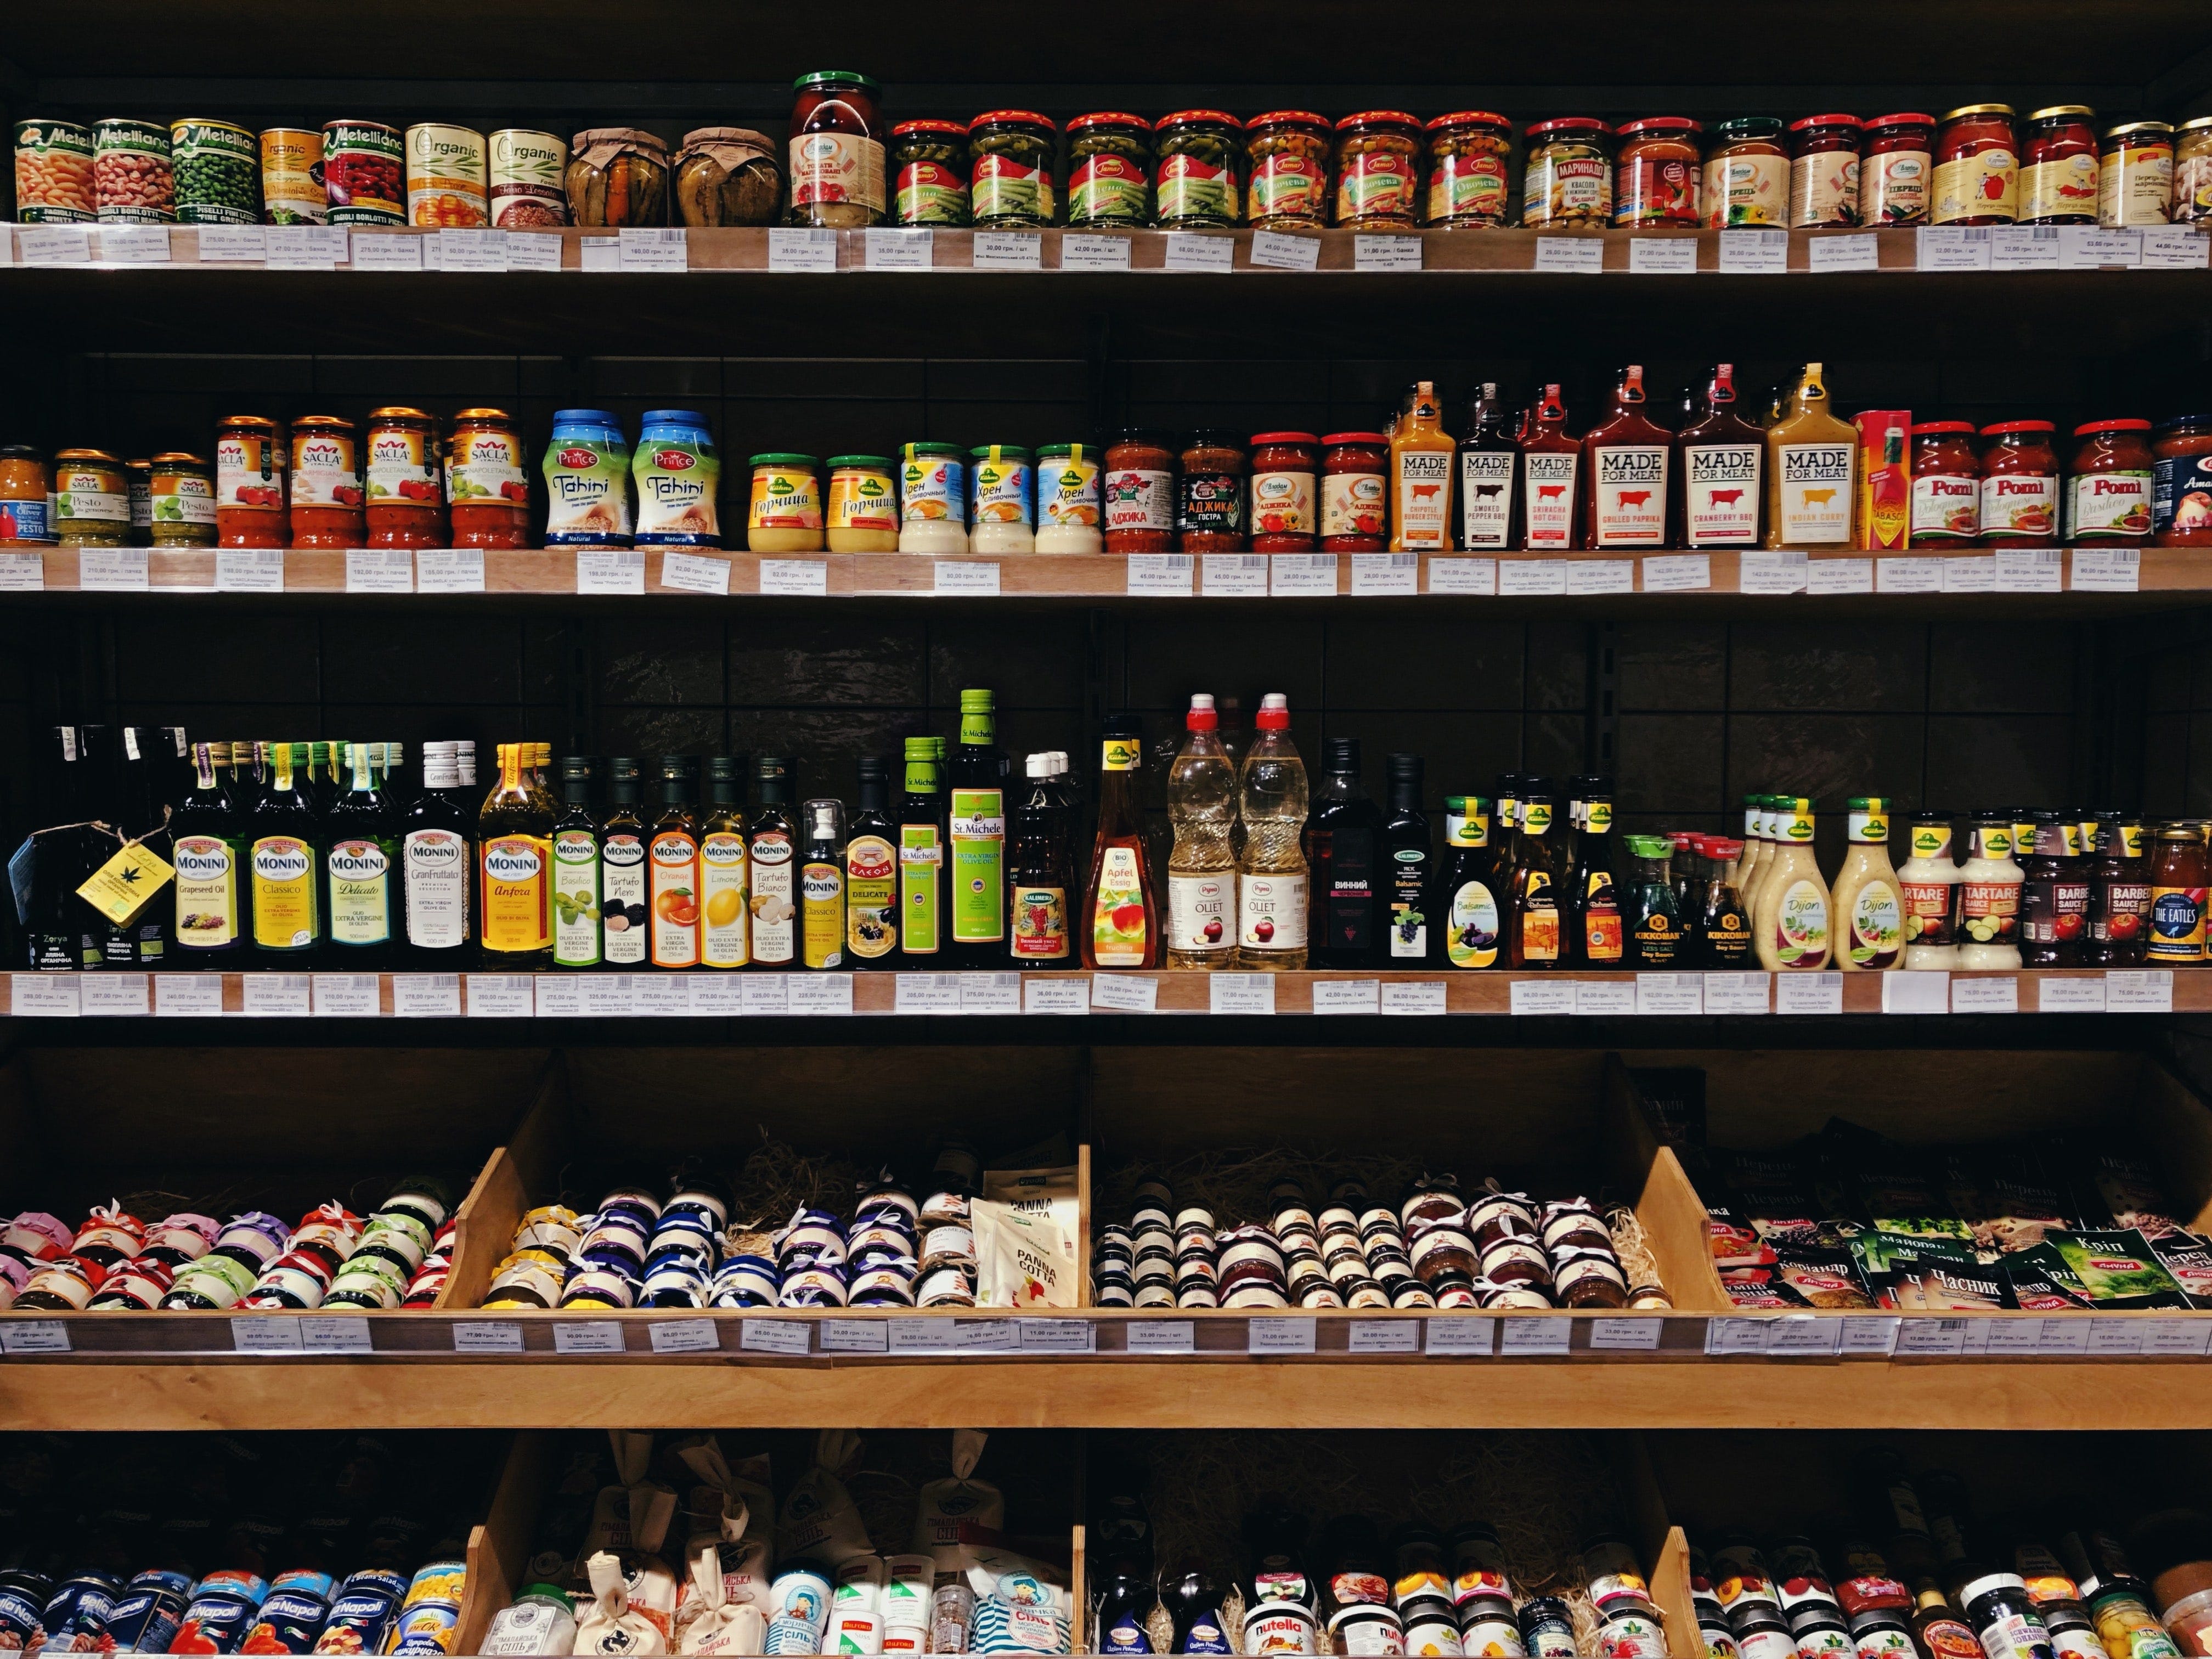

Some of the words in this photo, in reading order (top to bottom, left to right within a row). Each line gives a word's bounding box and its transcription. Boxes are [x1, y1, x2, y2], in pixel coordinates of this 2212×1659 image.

[416, 129, 478, 158] Organic
[498, 137, 557, 162] Organic
[1559, 162, 1603, 177] МАРИНАДО
[558, 452, 596, 465] Prince
[655, 454, 693, 466] Prince
[1404, 458, 1447, 469] MADE
[1467, 458, 1509, 469] MADE
[1602, 455, 1661, 470] MADE
[1693, 453, 1754, 470] MADE
[1786, 452, 1847, 469] MADE
[1530, 459, 1572, 470] MADE
[1601, 472, 1626, 481] FOR
[1629, 471, 1662, 479] MEAT
[1692, 470, 1718, 479] FOR
[1722, 469, 1755, 478] MEAT
[1786, 469, 1810, 478] FOR
[1814, 469, 1848, 477] MEAT
[553, 476, 608, 499] Tahini
[647, 476, 703, 500] Tahini
[904, 483, 925, 495] Хрен
[978, 485, 1001, 498] Хрен
[910, 489, 946, 500] сливочный
[984, 493, 1021, 502] сливочный
[1057, 488, 1084, 500] Хрен
[74, 496, 101, 506] Pesto
[182, 501, 208, 511] Pesto
[755, 494, 808, 518] Горчица
[843, 498, 894, 517] Горчица
[1188, 502, 1233, 514] АДЖИКА
[1112, 512, 1147, 524] АДЖИКА
[1873, 510, 1905, 520] TABASCO
[18, 524, 44, 533] PESTO
[414, 847, 454, 857] MONINI
[178, 857, 224, 868] MONINI
[257, 857, 304, 869] MONINI
[332, 857, 383, 870] MONINI
[488, 857, 537, 870] MONINI
[411, 869, 458, 879] GranFruttato
[661, 872, 689, 883] Orange
[756, 873, 788, 882] Tartufo
[1108, 868, 1133, 879] Apfel
[561, 876, 590, 885] Basilico
[609, 877, 639, 886] Tartufo
[1110, 879, 1131, 888] Essig
[1335, 880, 1367, 889] ВИННИЙ
[180, 885, 213, 895] Grapeseed
[216, 885, 224, 893] Oil
[263, 884, 300, 894] Classico
[337, 883, 379, 895] Delicato
[495, 886, 531, 896] Anfora
[614, 887, 634, 896] Nero
[758, 883, 787, 893] Bianco
[1202, 885, 1218, 894] Руна
[1255, 885, 1269, 893] Руна
[1966, 887, 2018, 899] TARTARE
[1195, 902, 1223, 913] ОЦЕТ
[1249, 902, 1276, 913] ОЦЕТ
[1457, 901, 1492, 911] Balsamic
[1788, 900, 1819, 911] Dijon
[1862, 900, 1893, 911] Dijon
[805, 907, 835, 916] Classico
[2156, 908, 2166, 921] THE
[2169, 909, 2196, 923] EATLES
[1106, 944, 1133, 952] fruchtig
[2075, 1237, 2125, 1252] Кріп
[1018, 1249, 1057, 1279] PANNA
[1780, 1261, 1848, 1276] Коріандр
[1019, 1261, 1055, 1287] COTTA
[1931, 1269, 2001, 1295] Часник
[378, 1576, 397, 1585] Salad
[79, 1595, 109, 1612] Bella
[341, 1601, 382, 1614] Napoli
[195, 1604, 240, 1618] Napoli
[278, 1602, 321, 1617] Napoli
[1018, 1622, 1047, 1630] МОРСЬКА
[1256, 1619, 1302, 1638] nutella
[785, 1630, 811, 1643] СІЛЬ
[500, 1642, 525, 1652] СІЛЬ
